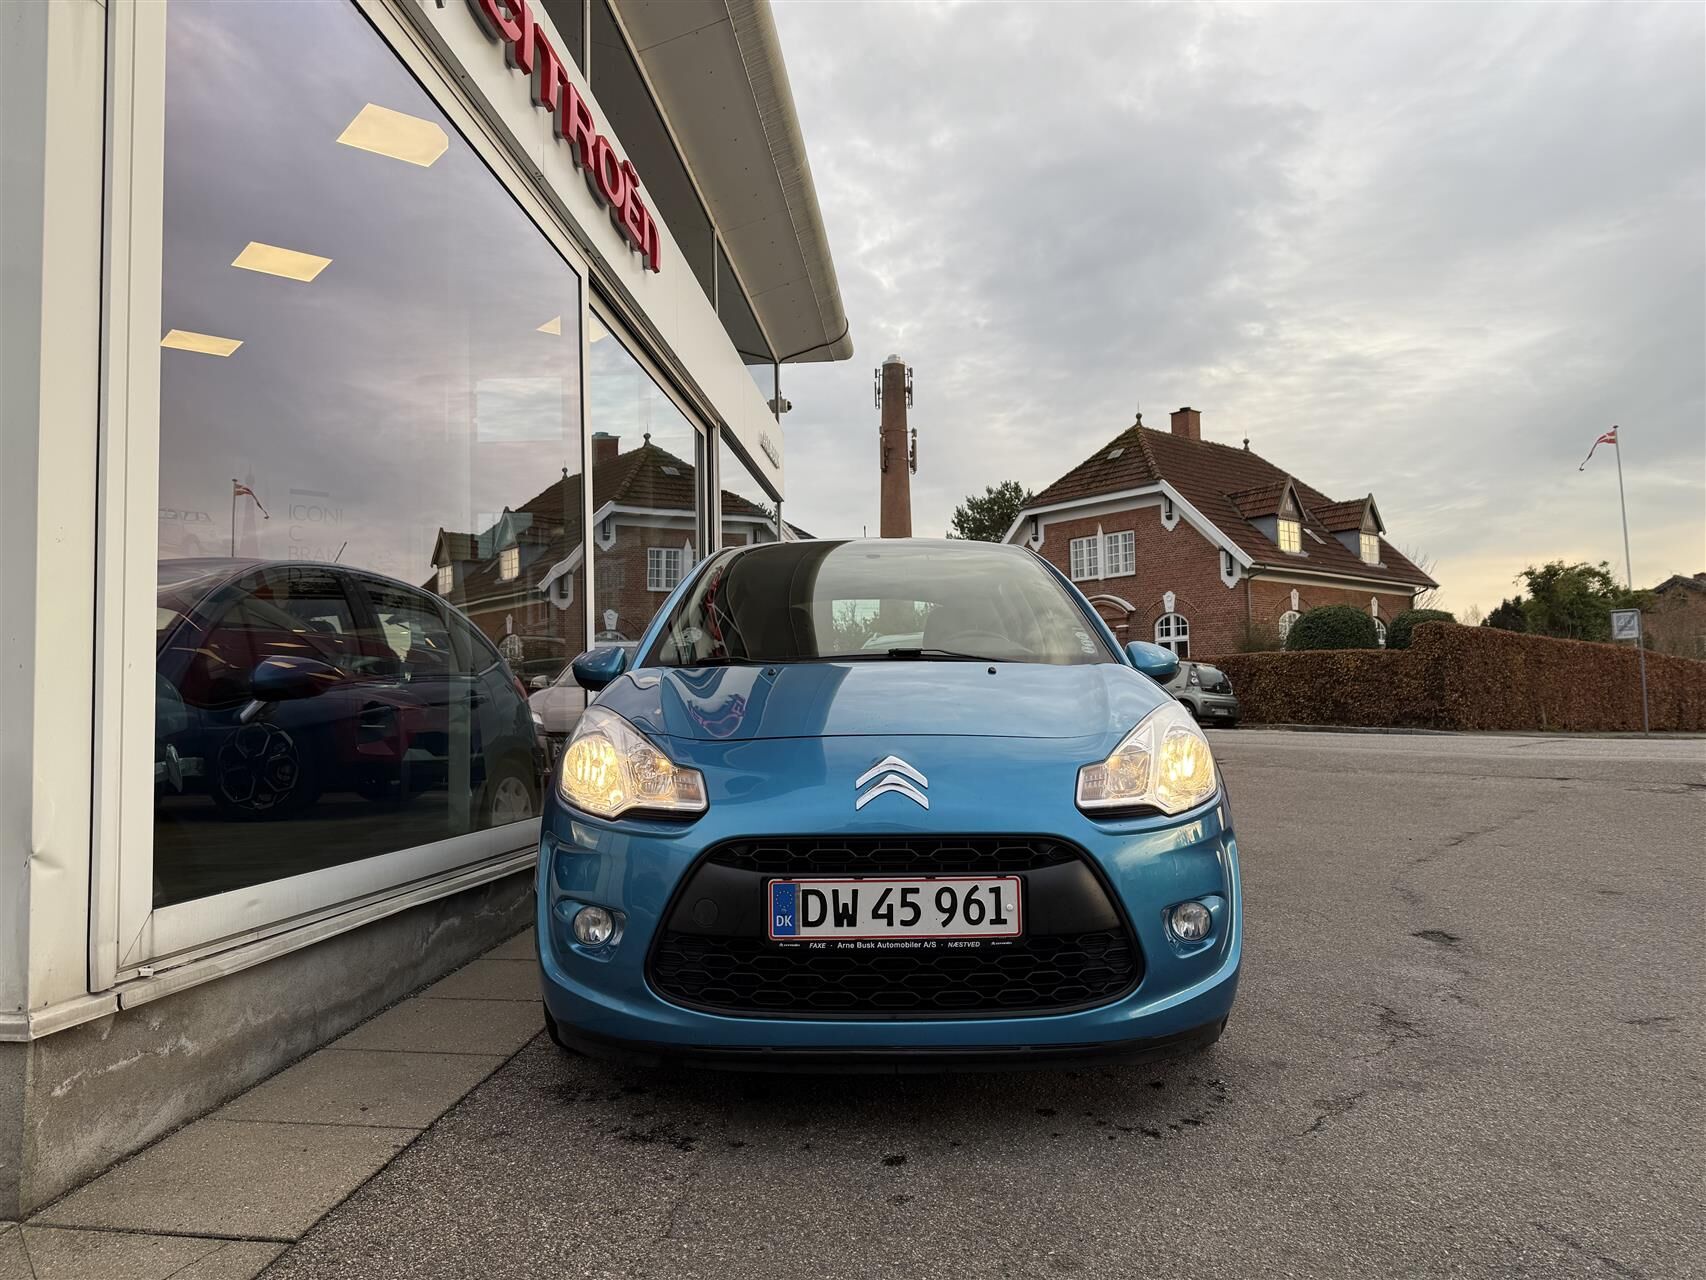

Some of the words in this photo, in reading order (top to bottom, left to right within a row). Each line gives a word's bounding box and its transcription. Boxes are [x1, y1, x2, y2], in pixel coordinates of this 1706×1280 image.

[801, 888, 859, 928] DW
[871, 887, 922, 927] 45
[934, 884, 1008, 928] 961
[776, 915, 793, 927] DK
[837, 941, 855, 949] Arne
[856, 941, 875, 949] Busk
[876, 940, 922, 949] Automobiler
[922, 940, 937, 948] A/S
[947, 940, 981, 948] NÆSTVED
